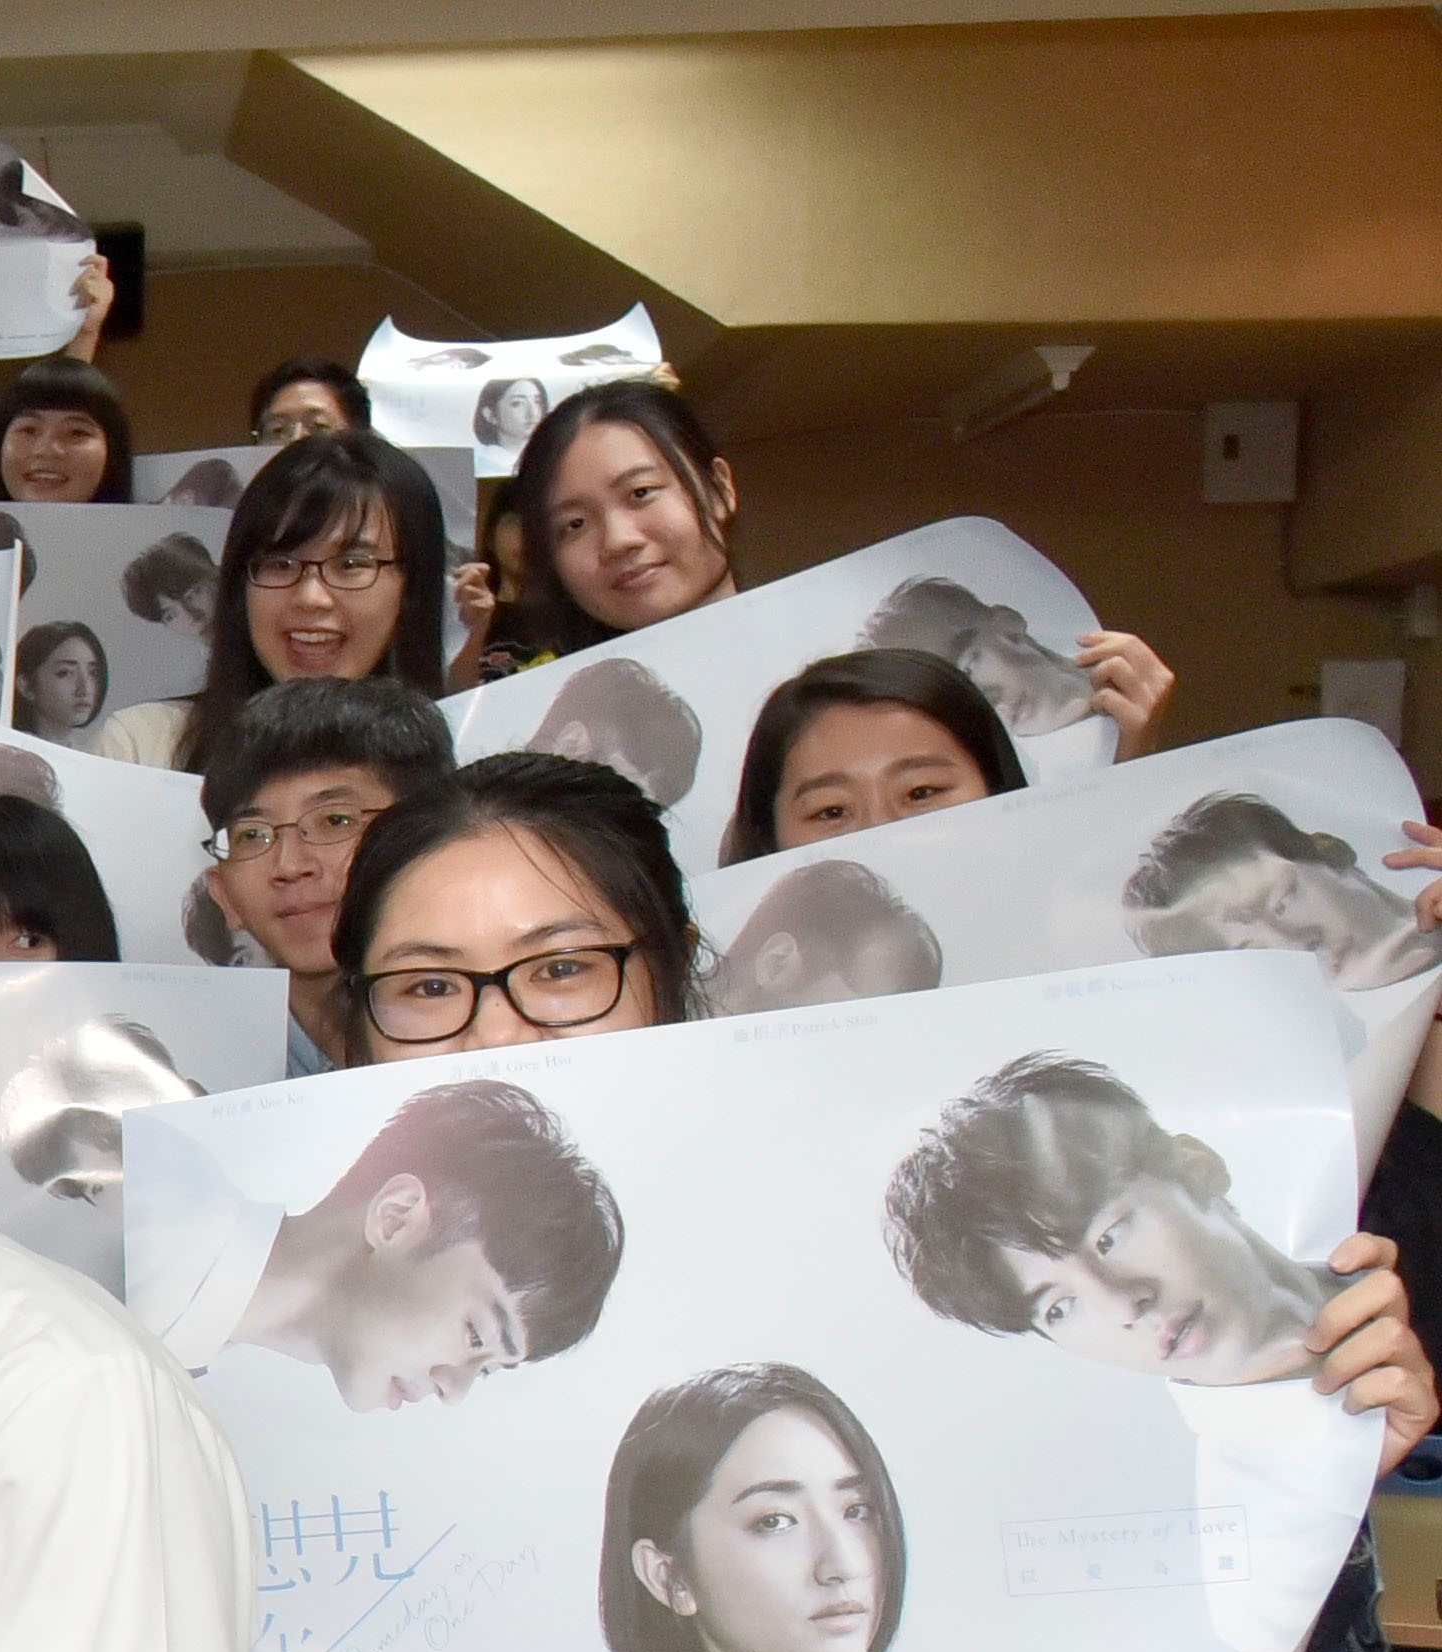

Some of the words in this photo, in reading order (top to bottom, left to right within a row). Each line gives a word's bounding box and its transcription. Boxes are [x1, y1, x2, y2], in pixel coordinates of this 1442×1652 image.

[1010, 1530, 1049, 1550] The
[1058, 1526, 1143, 1547] Mystery
[1187, 1518, 1239, 1536] Love
